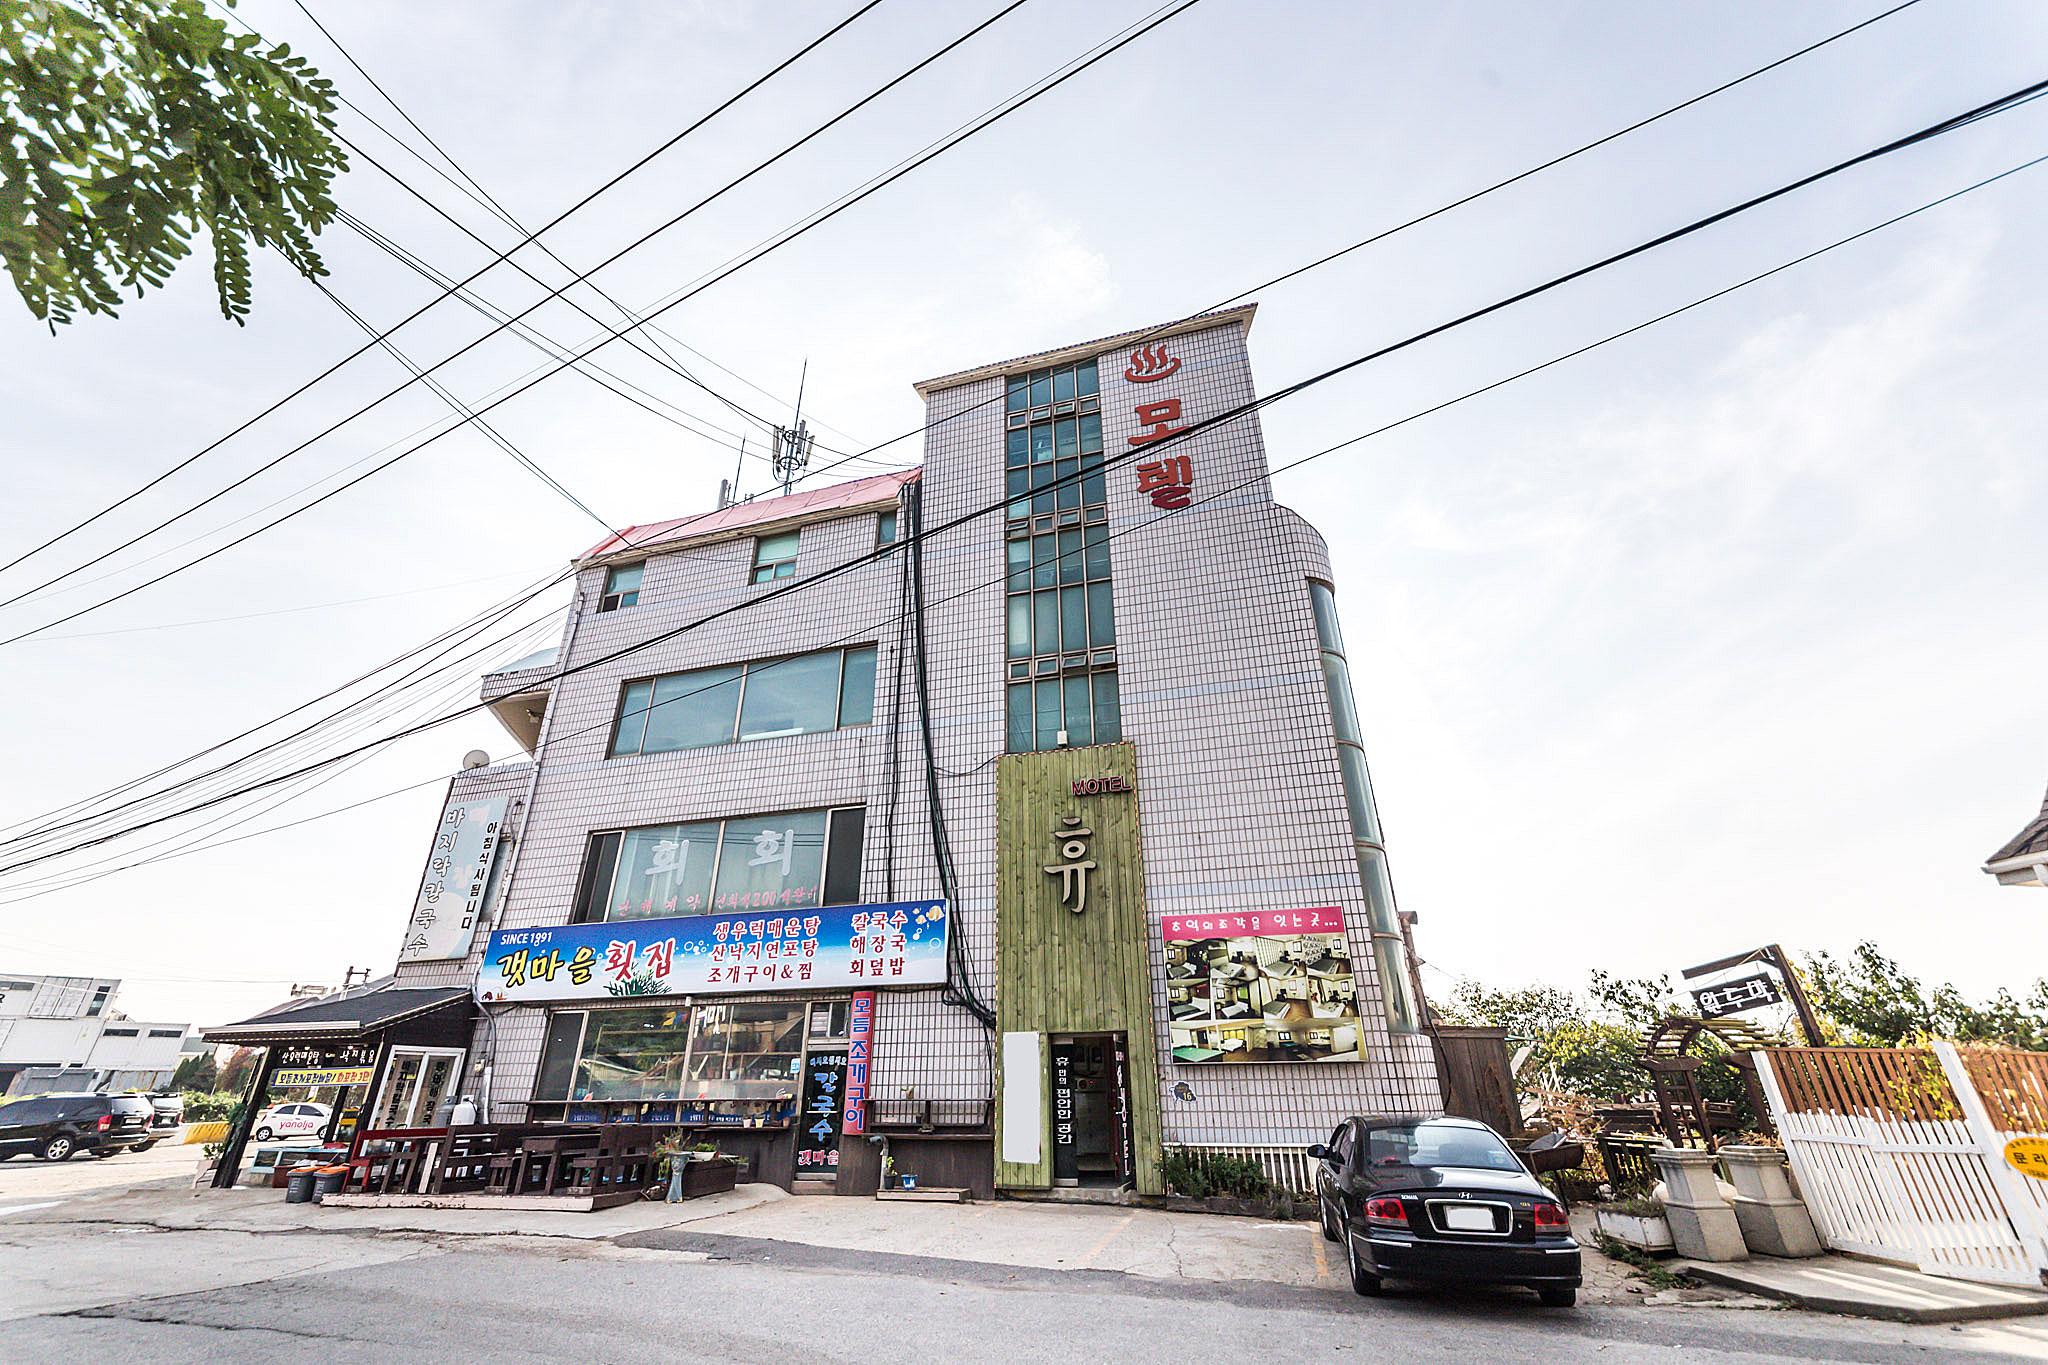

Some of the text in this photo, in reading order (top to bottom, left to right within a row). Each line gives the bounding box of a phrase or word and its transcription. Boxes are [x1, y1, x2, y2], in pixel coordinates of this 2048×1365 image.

[1127, 398, 1194, 511] 모텔
[1071, 775, 1132, 796] MOTEL
[644, 839, 690, 886] 회
[747, 829, 795, 876] 회
[1043, 816, 1098, 914] 휴
[406, 807, 466, 957] 바지락칼국수
[712, 915, 822, 942] 생우럭매운탕
[851, 910, 908, 933] 칼국수
[500, 931, 553, 946] SINCE 1991
[710, 939, 819, 963] 산낙지연포탕
[851, 934, 908, 955] 해장국
[497, 939, 676, 989] 갯마을 횟집
[707, 961, 813, 985] 조개구이&찜
[849, 957, 906, 978] 회덮밥
[1699, 978, 1775, 1015] 원두막
[809, 1071, 839, 1143] 칼국수
[1056, 1088, 1072, 1120] 편안한
[279, 1120, 314, 1131] yanolja
[1057, 1123, 1073, 1144] 공간
[797, 1149, 840, 1167] 갯마을
